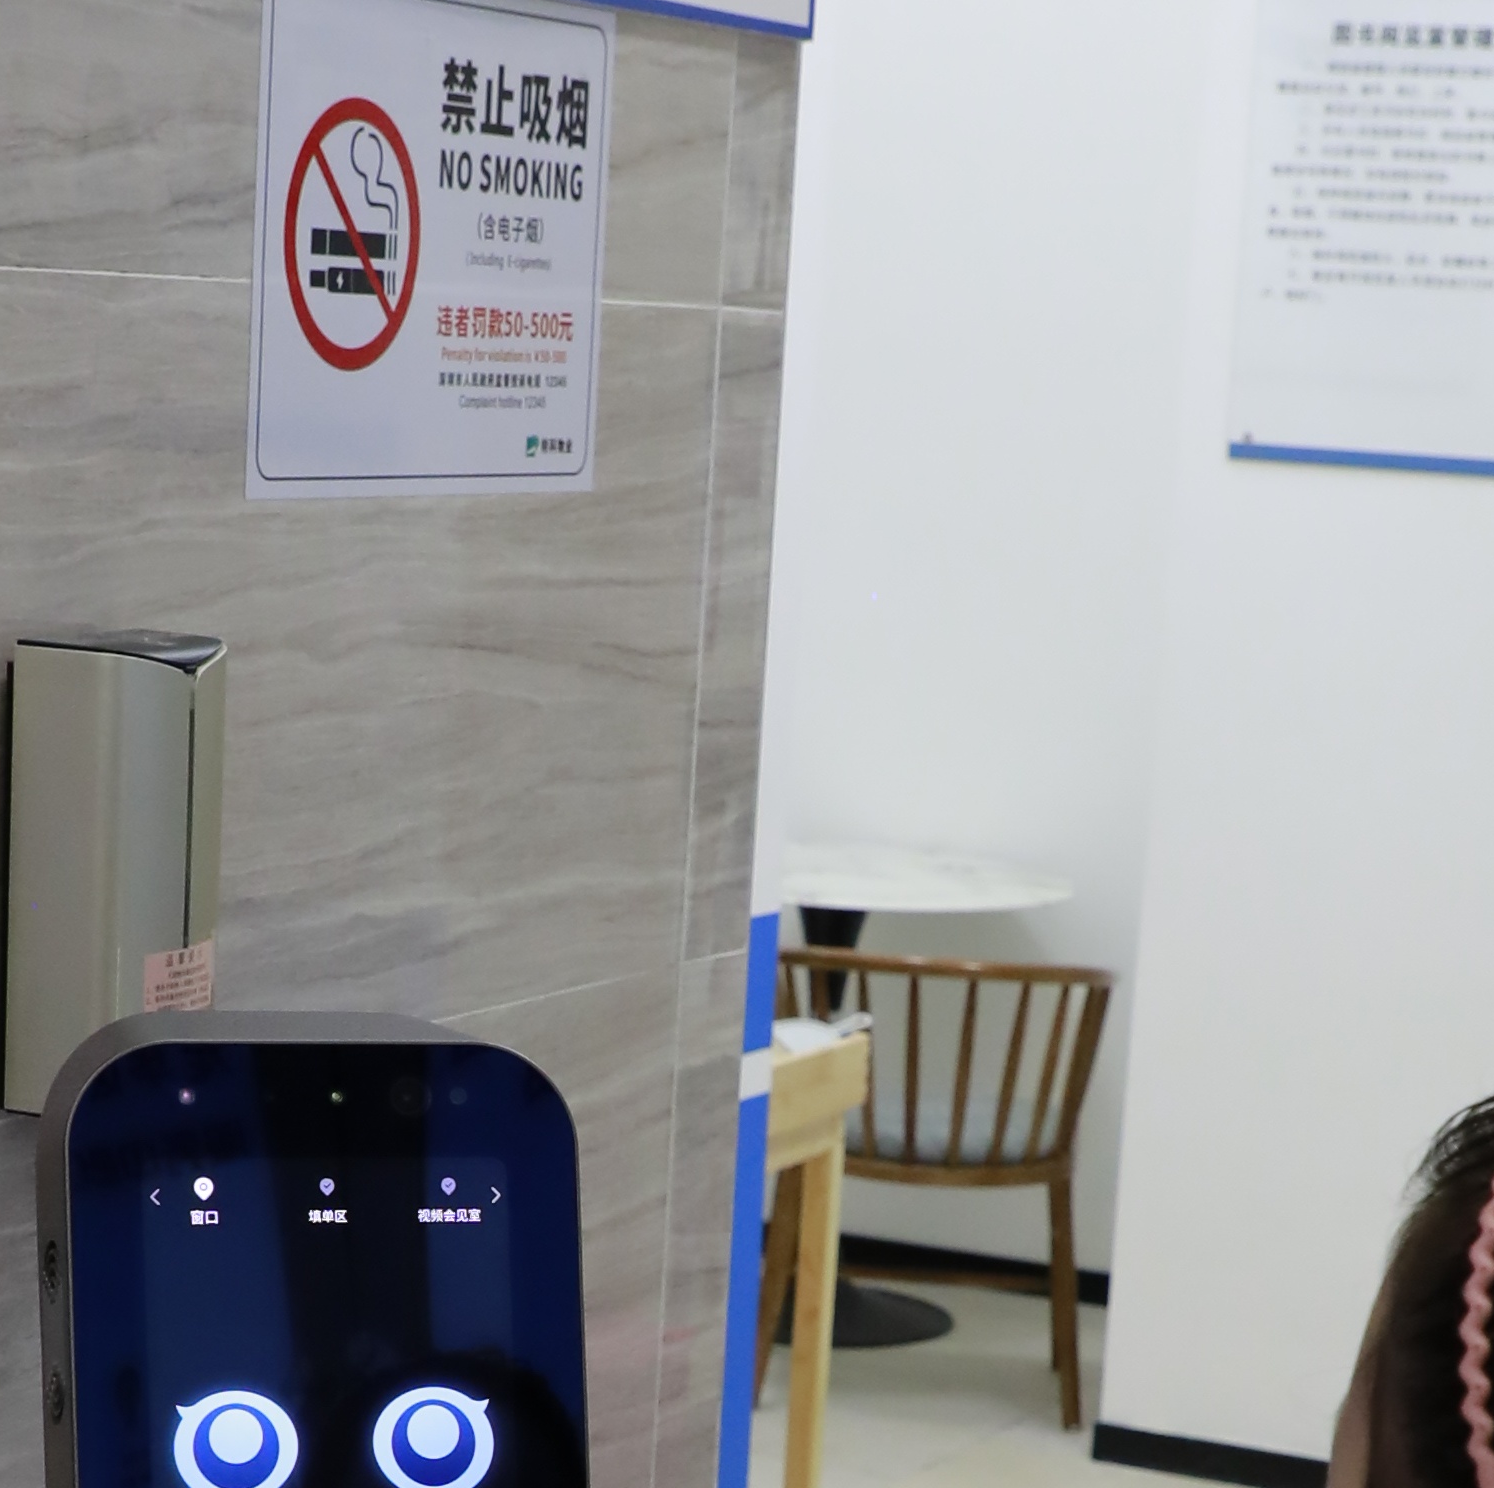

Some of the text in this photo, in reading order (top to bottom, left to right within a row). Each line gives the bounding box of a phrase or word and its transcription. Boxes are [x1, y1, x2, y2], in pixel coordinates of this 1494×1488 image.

[441, 57, 590, 149] 禁止吸烟
[439, 150, 584, 202] NO SMOKING
[437, 306, 573, 341] 违者罚款50-500元
[190, 1210, 219, 1225] 窗口
